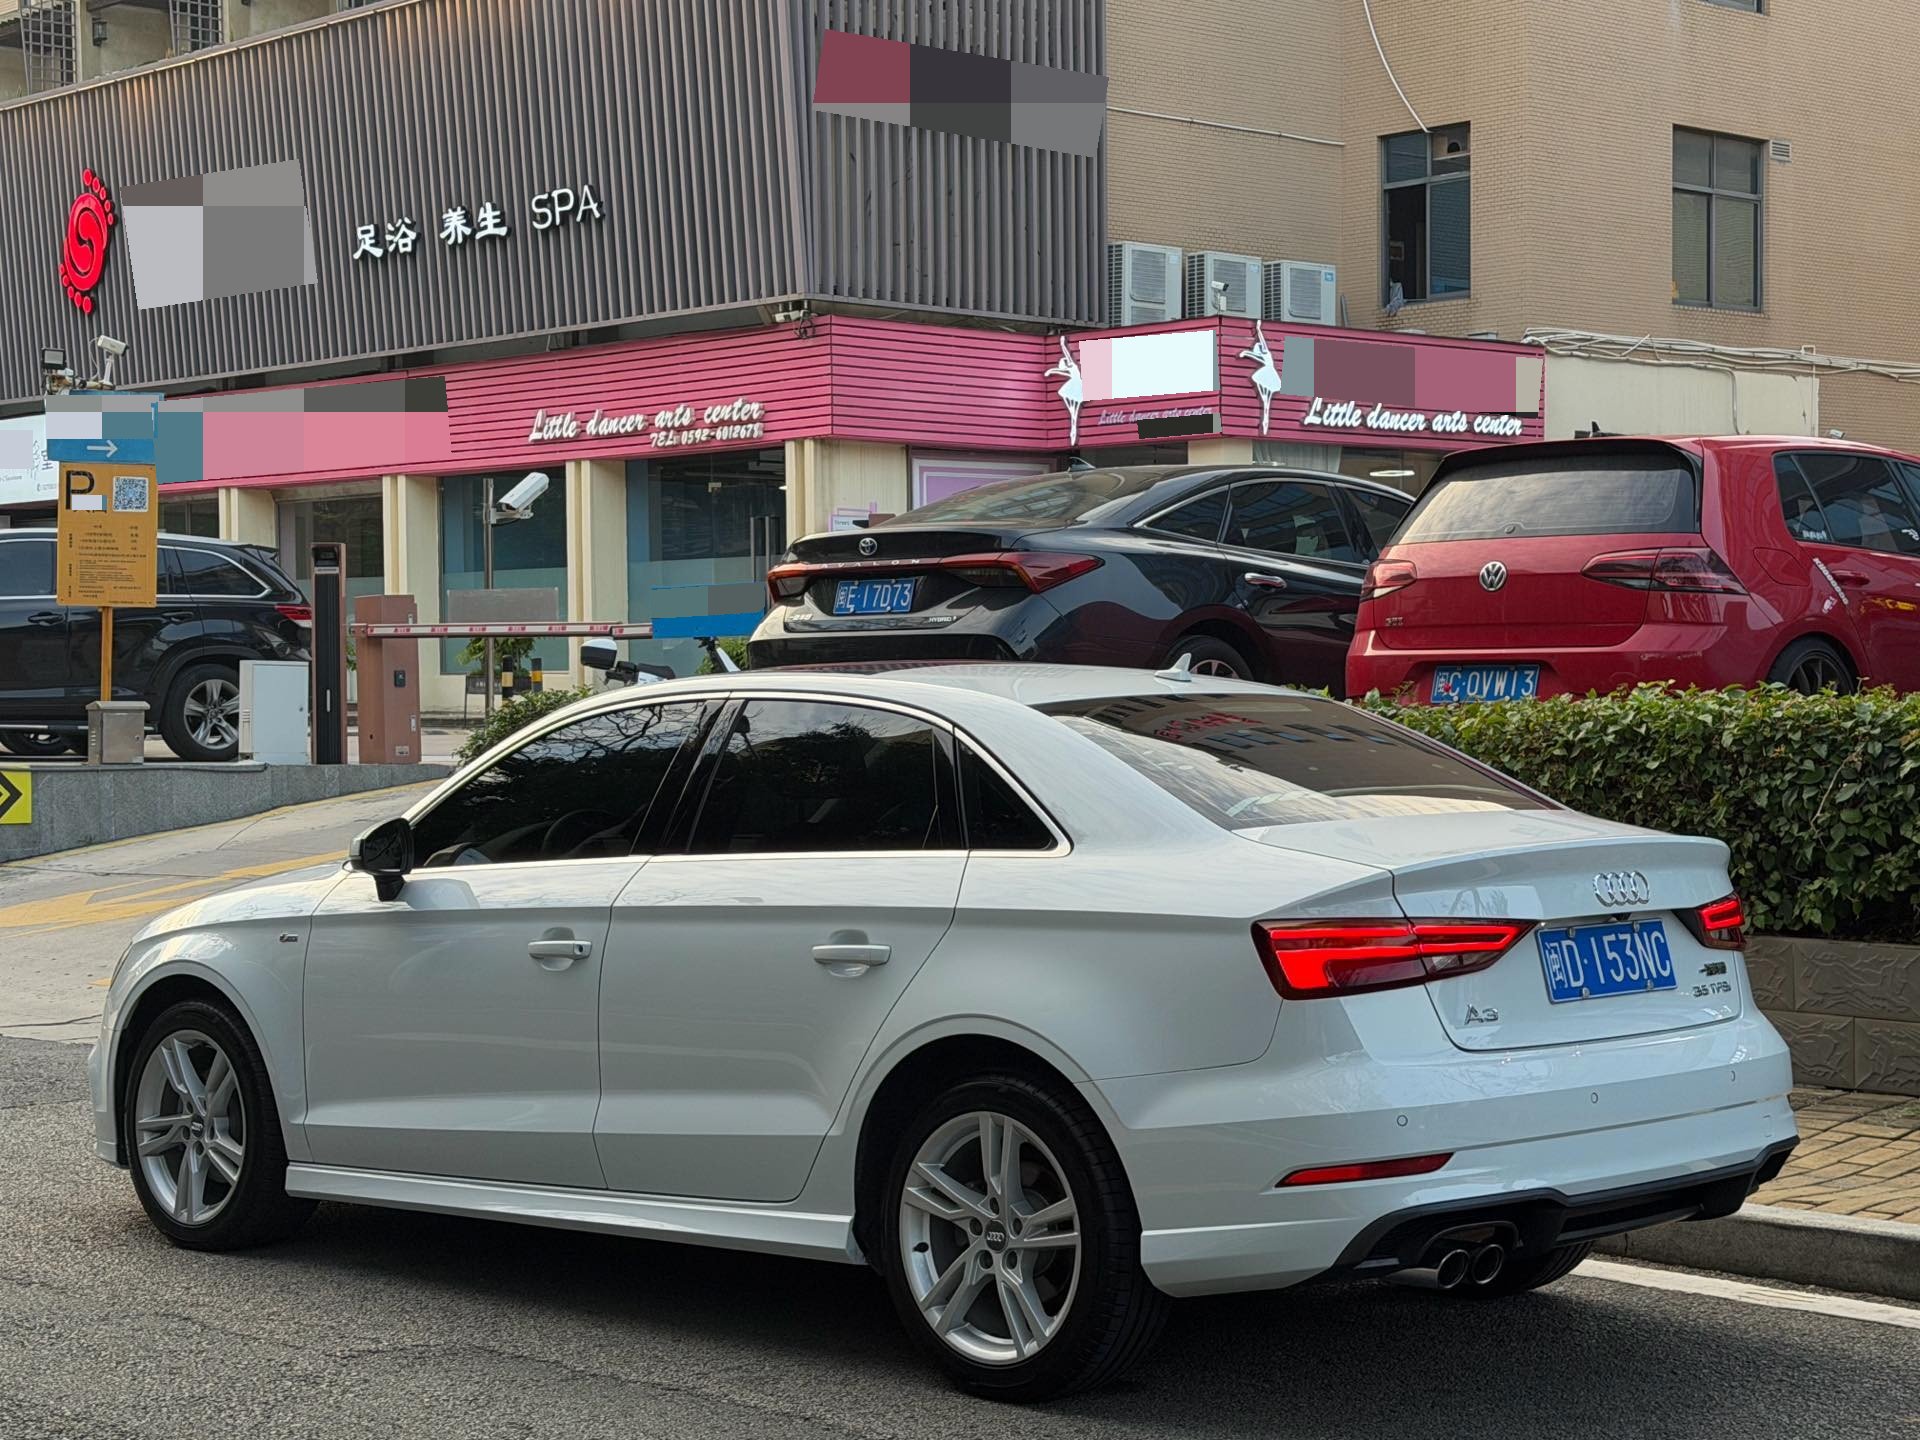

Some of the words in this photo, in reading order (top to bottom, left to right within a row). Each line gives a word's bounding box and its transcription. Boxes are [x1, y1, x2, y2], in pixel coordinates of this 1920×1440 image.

[353, 216, 417, 260] 足浴
[439, 201, 508, 245] 养生
[531, 184, 601, 230] SPA
[528, 409, 578, 443] Little
[586, 409, 648, 437] dancer
[654, 404, 694, 429] arts
[703, 398, 763, 425] center
[1098, 409, 1125, 425] Little
[1304, 397, 1362, 427] Little
[1366, 403, 1427, 431] dancer
[1432, 410, 1468, 433] arts
[1473, 414, 1523, 436] center
[821, 558, 921, 569] AVALON
[1464, 1003, 1499, 1026] A3
